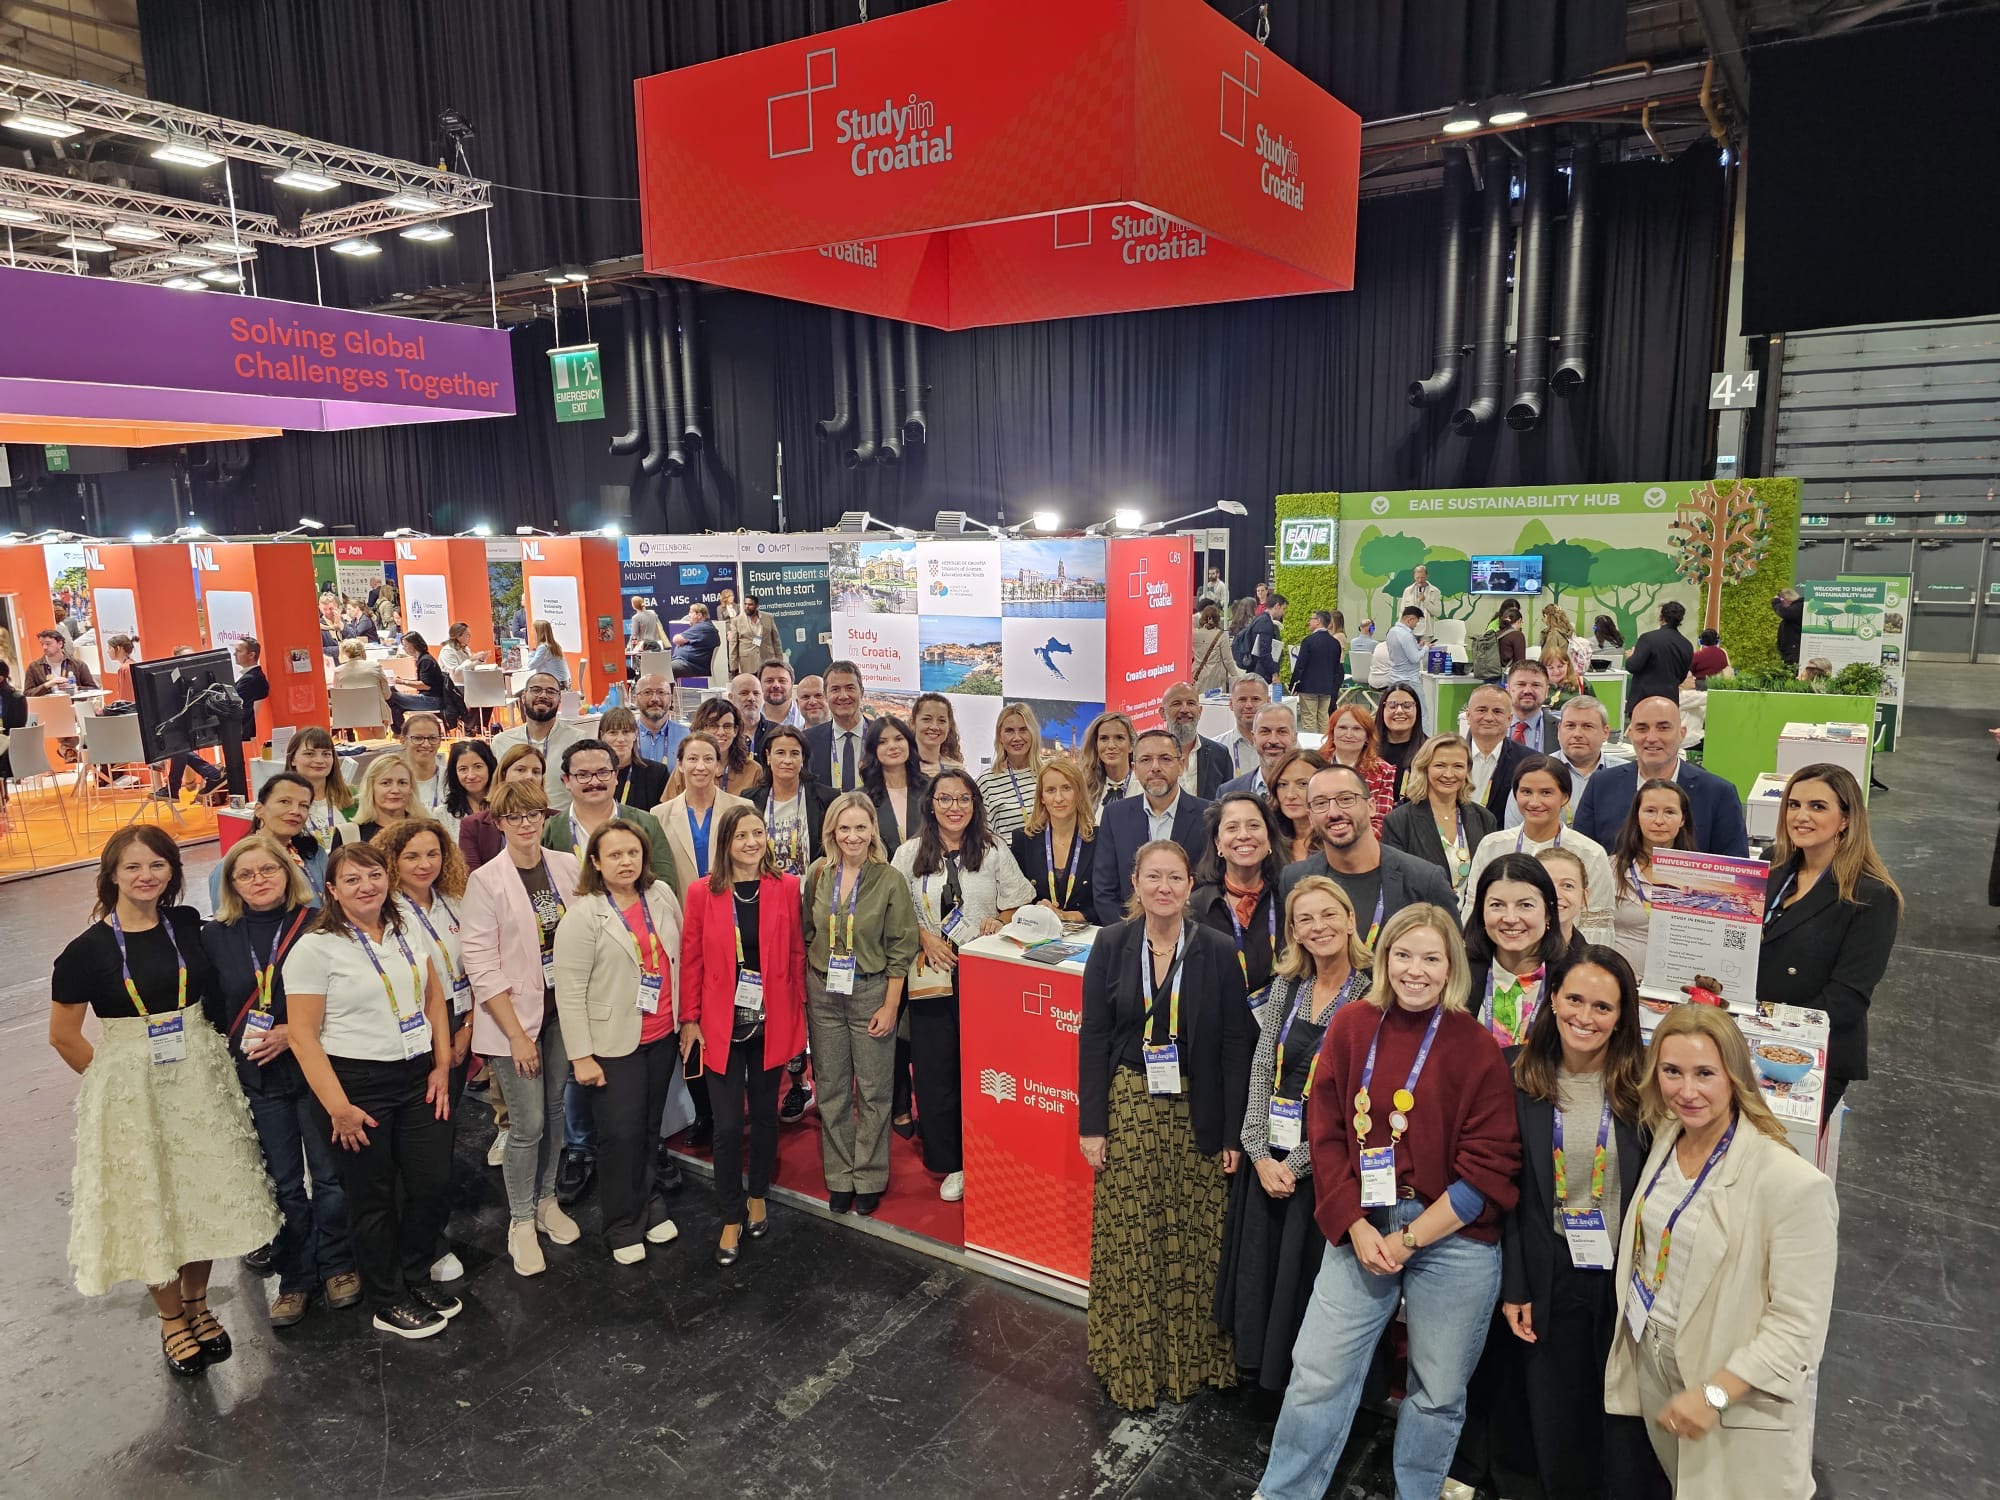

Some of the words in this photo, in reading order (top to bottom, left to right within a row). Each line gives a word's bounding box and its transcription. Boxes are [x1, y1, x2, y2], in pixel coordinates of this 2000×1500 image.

[851, 125, 953, 176] Croatia!
[1261, 162, 1304, 211] Croatia!
[1122, 233, 1207, 265] Croatia!
[230, 317, 337, 358] Solving
[344, 329, 425, 360] Global
[234, 352, 389, 393] Challenges
[395, 367, 499, 399] Together
[556, 388, 600, 403] EMERGENCY
[572, 402, 587, 413] EXIT
[1409, 498, 1444, 511] EAIE
[1448, 494, 1579, 510] SUSTAINABILITY
[1583, 493, 1621, 507] HUB
[1285, 528, 1329, 545] EAIE
[396, 541, 417, 561] NL
[522, 541, 546, 561] NL
[651, 543, 692, 552] WITTENBORG
[769, 544, 791, 552] OMPT
[84, 548, 105, 571] NL
[197, 547, 220, 571] NL
[624, 572, 656, 581] MUNICH
[682, 568, 702, 577] 200+
[718, 567, 732, 576] 50+
[749, 569, 781, 582] Ensure
[783, 568, 817, 581] student
[819, 569, 829, 578] su
[751, 585, 774, 597] from
[776, 583, 792, 595] the
[793, 583, 815, 595] start
[670, 595, 690, 605] MSc
[848, 628, 878, 643] Study
[861, 645, 901, 661] Croatia,
[880, 662, 892, 671] full
[1125, 669, 1147, 682] Croatia
[1147, 661, 1175, 678] explained
[1656, 857, 1702, 868] UNIVERSITY
[1702, 862, 1713, 870] OF
[1713, 864, 1762, 876] DUBROVNIK
[1023, 1078, 1080, 1104] University
[1023, 1096, 1037, 1107] of
[1038, 1097, 1065, 1115] Split
